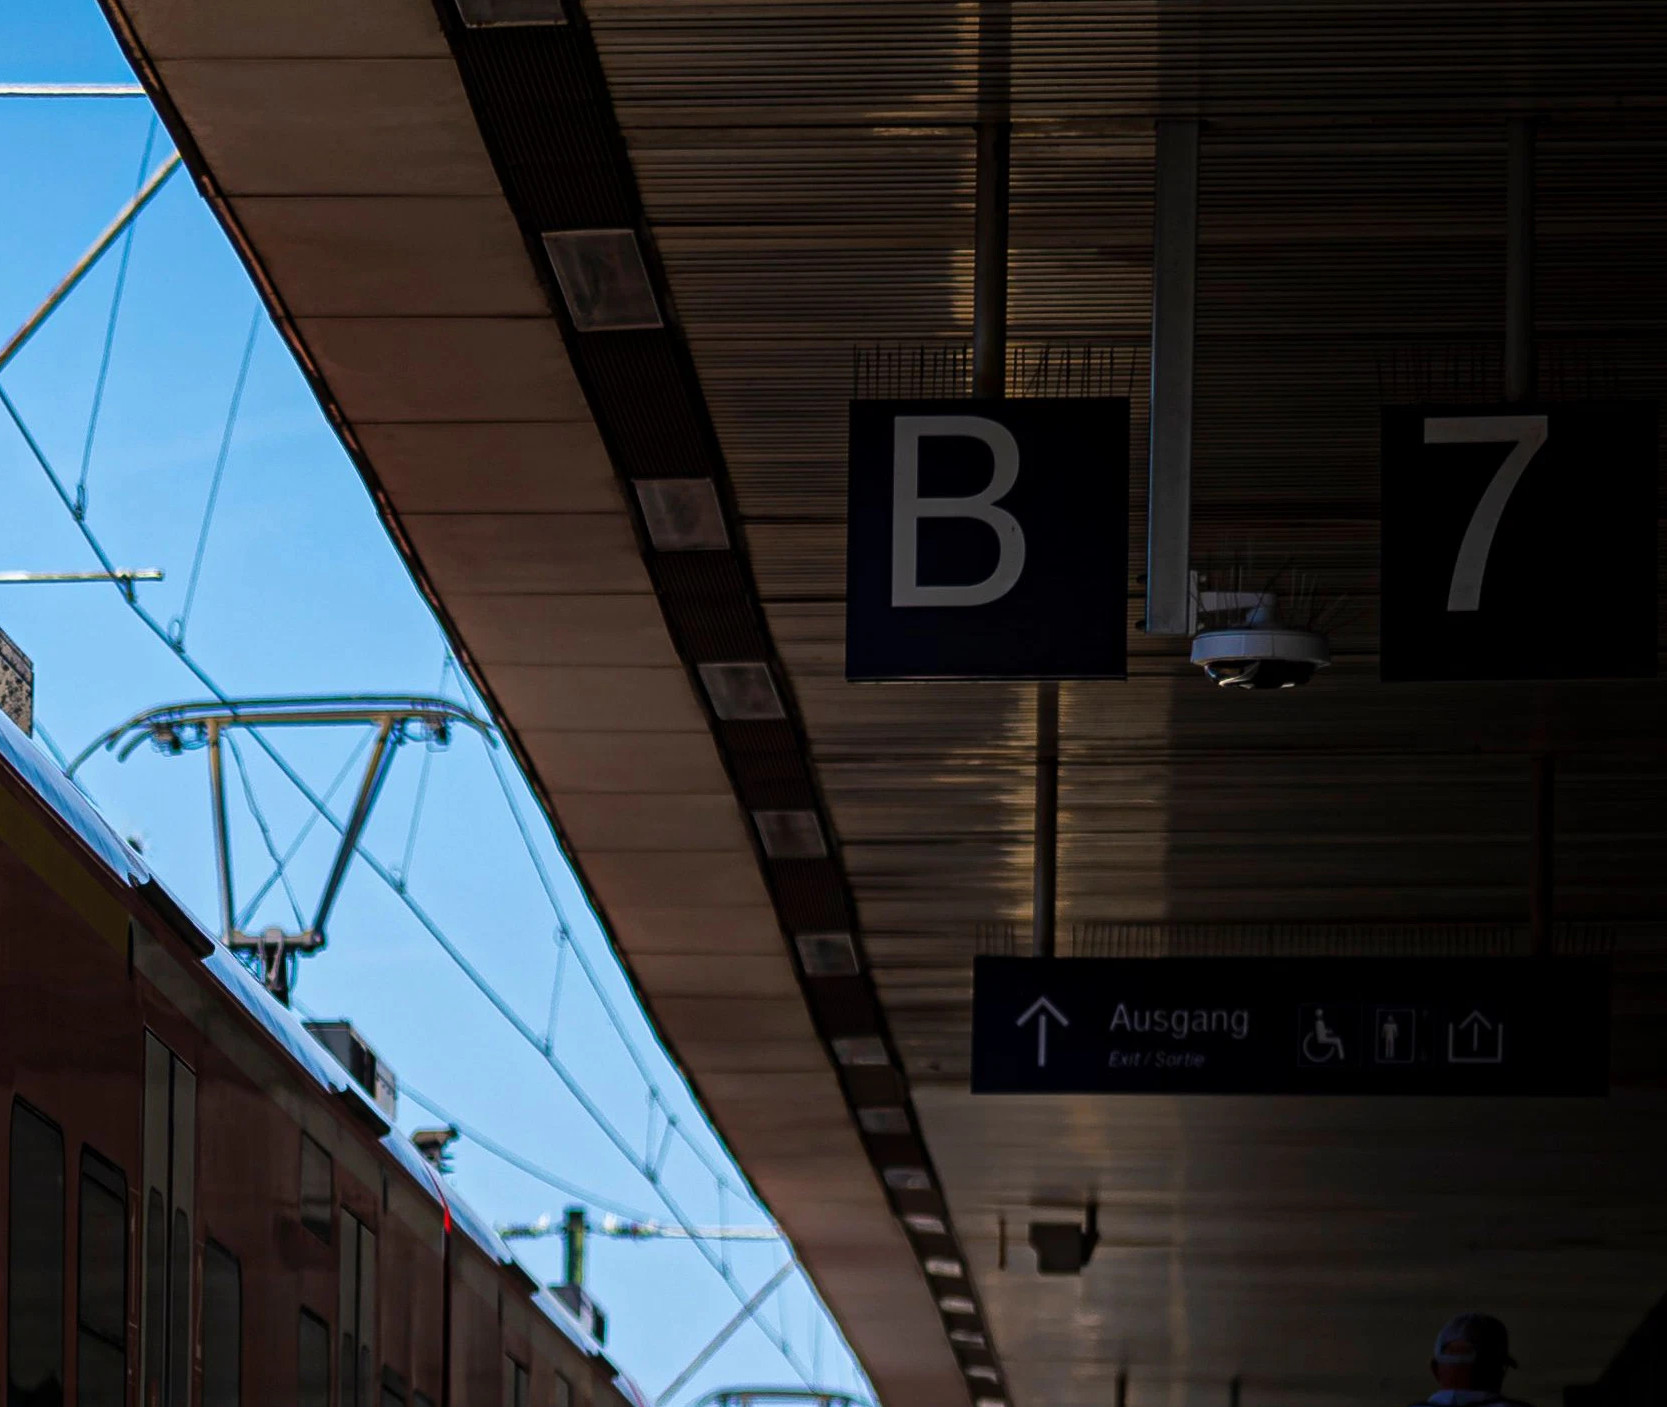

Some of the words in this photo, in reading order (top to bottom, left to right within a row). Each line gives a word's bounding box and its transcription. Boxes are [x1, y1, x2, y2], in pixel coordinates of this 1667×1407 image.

[891, 415, 1026, 607] B
[1424, 414, 1549, 612] 7
[1108, 1049, 1141, 1068] Exit
[1154, 1049, 1206, 1068] Sortie
[1109, 1001, 1249, 1039] Ausgang
